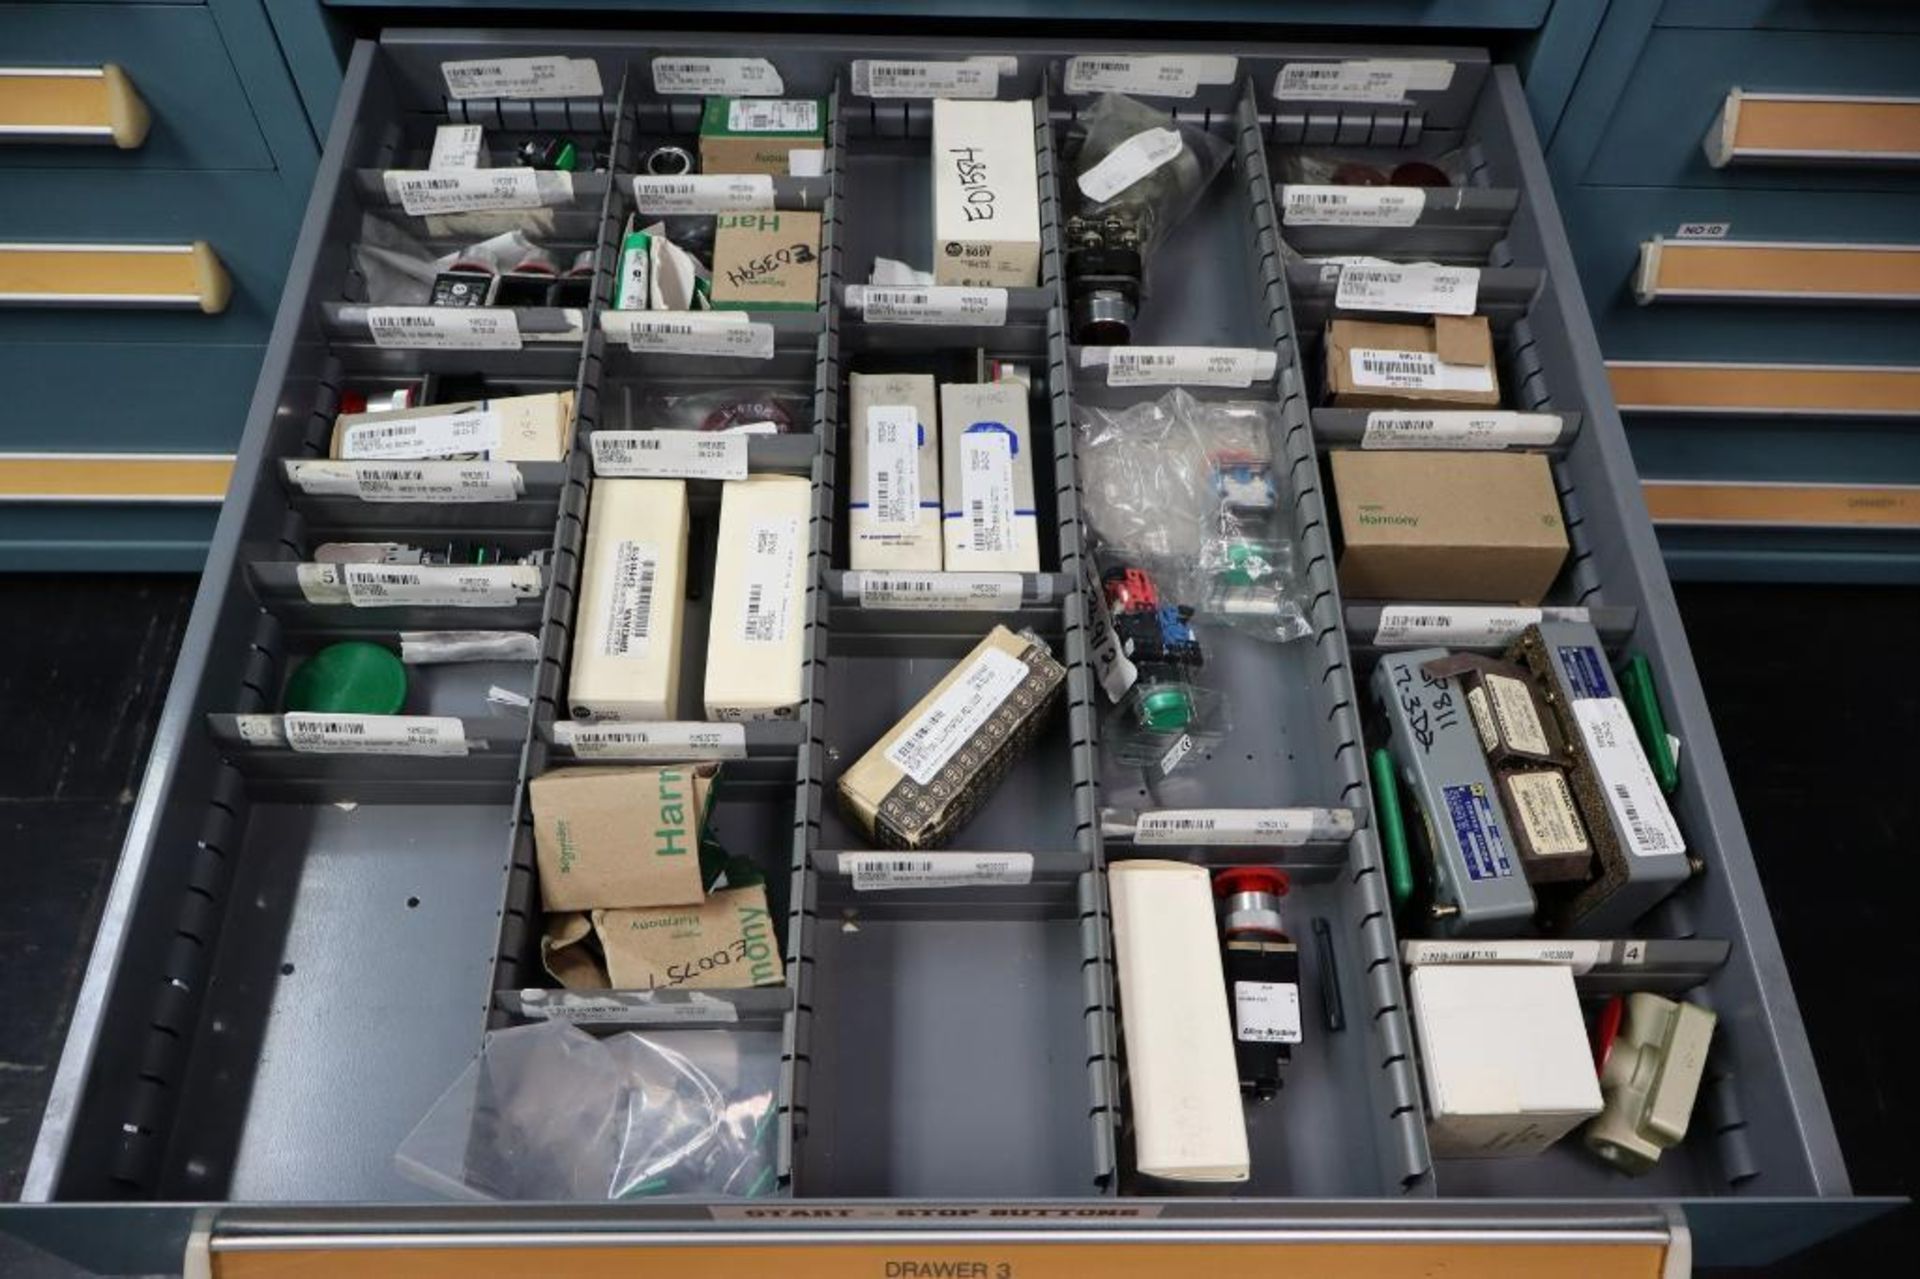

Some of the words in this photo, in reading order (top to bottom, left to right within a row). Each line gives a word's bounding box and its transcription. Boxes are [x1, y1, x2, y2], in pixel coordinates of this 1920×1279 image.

[719, 215, 779, 232] Har
[1359, 513, 1418, 527] Harmony
[321, 570, 335, 584] 5
[1626, 947, 1639, 960] 4
[744, 1208, 854, 1218] START
[896, 1208, 979, 1218] STOP
[989, 1208, 1140, 1218] BUTTONS
[885, 1261, 988, 1278] DRAWER
[997, 1262, 1012, 1279] 3
